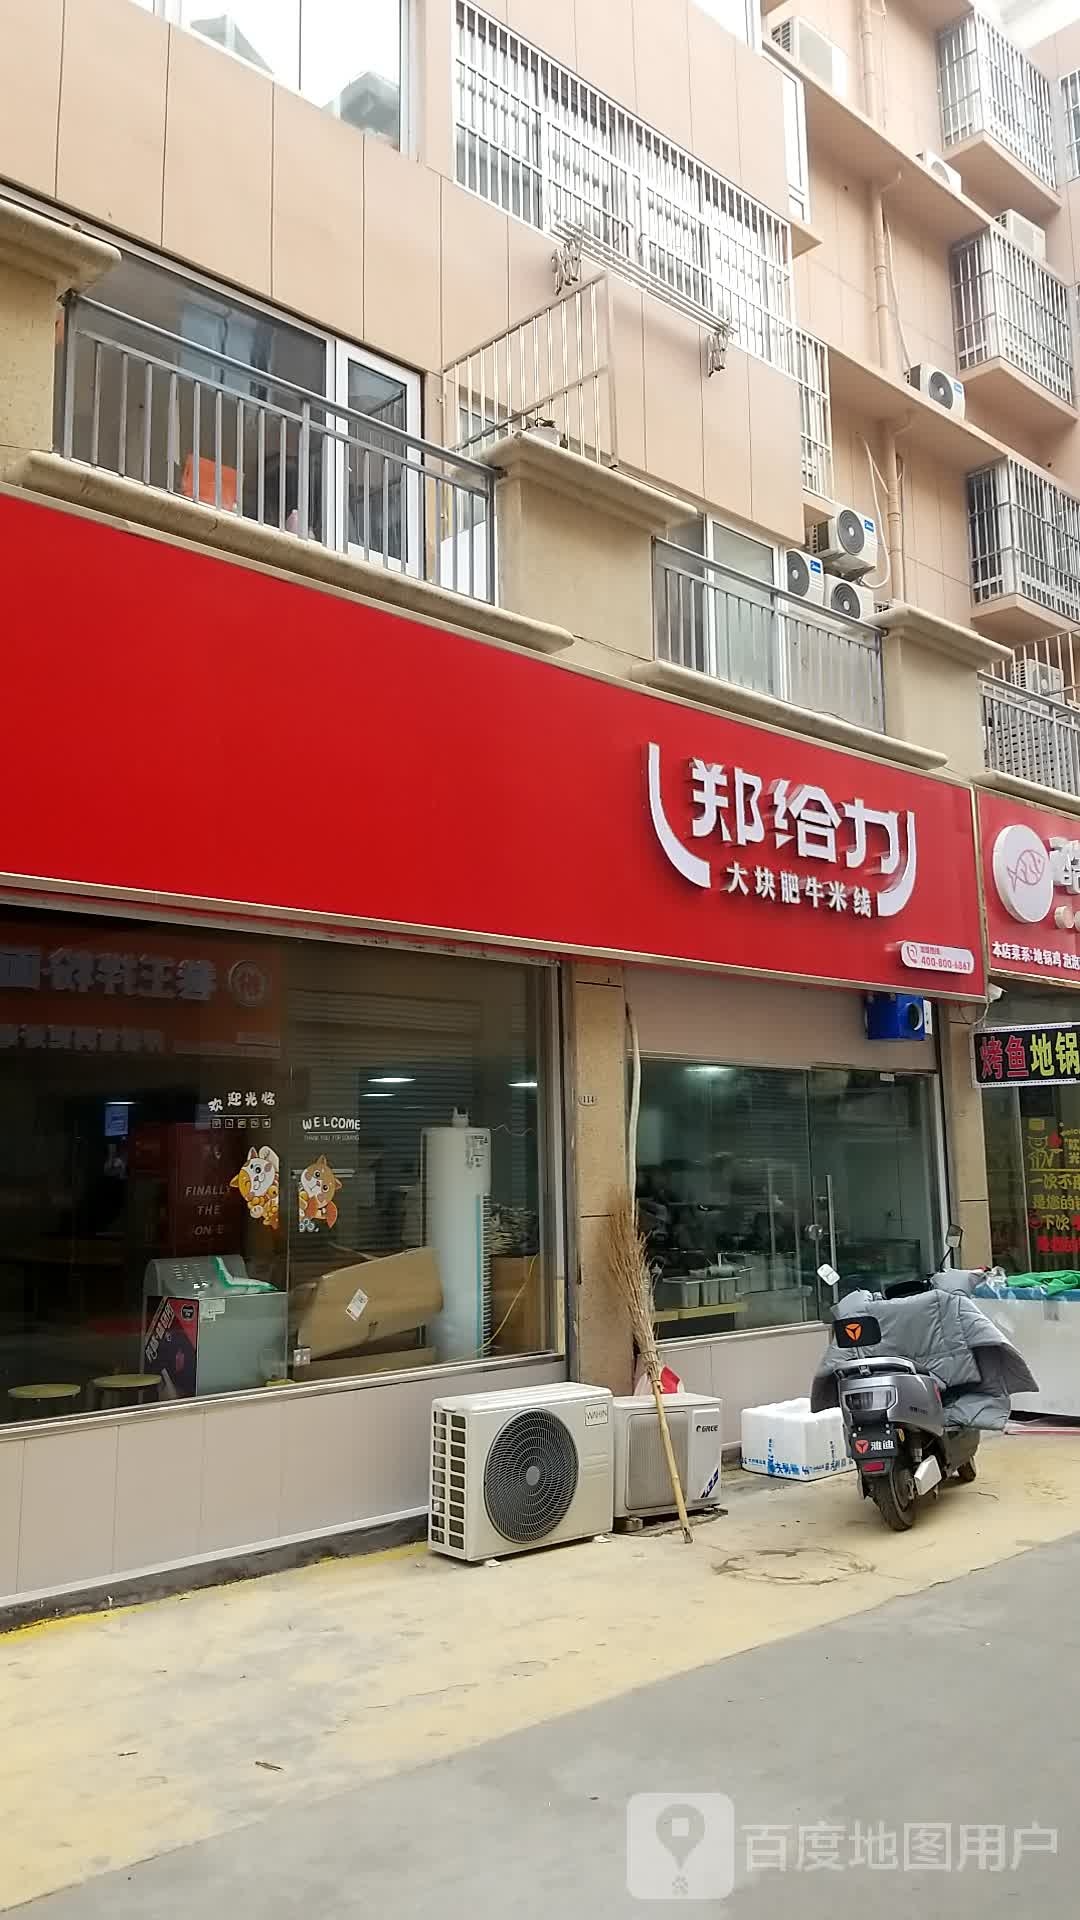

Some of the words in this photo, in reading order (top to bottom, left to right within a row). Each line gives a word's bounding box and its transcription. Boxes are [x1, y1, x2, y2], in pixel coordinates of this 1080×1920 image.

[691, 757, 899, 874] 郑给力
[726, 861, 872, 918] 大块肥牛米线
[208, 1091, 275, 1112] 欢迎光临
[302, 1116, 361, 1130] WELCOME
[197, 1204, 222, 1216] THE
